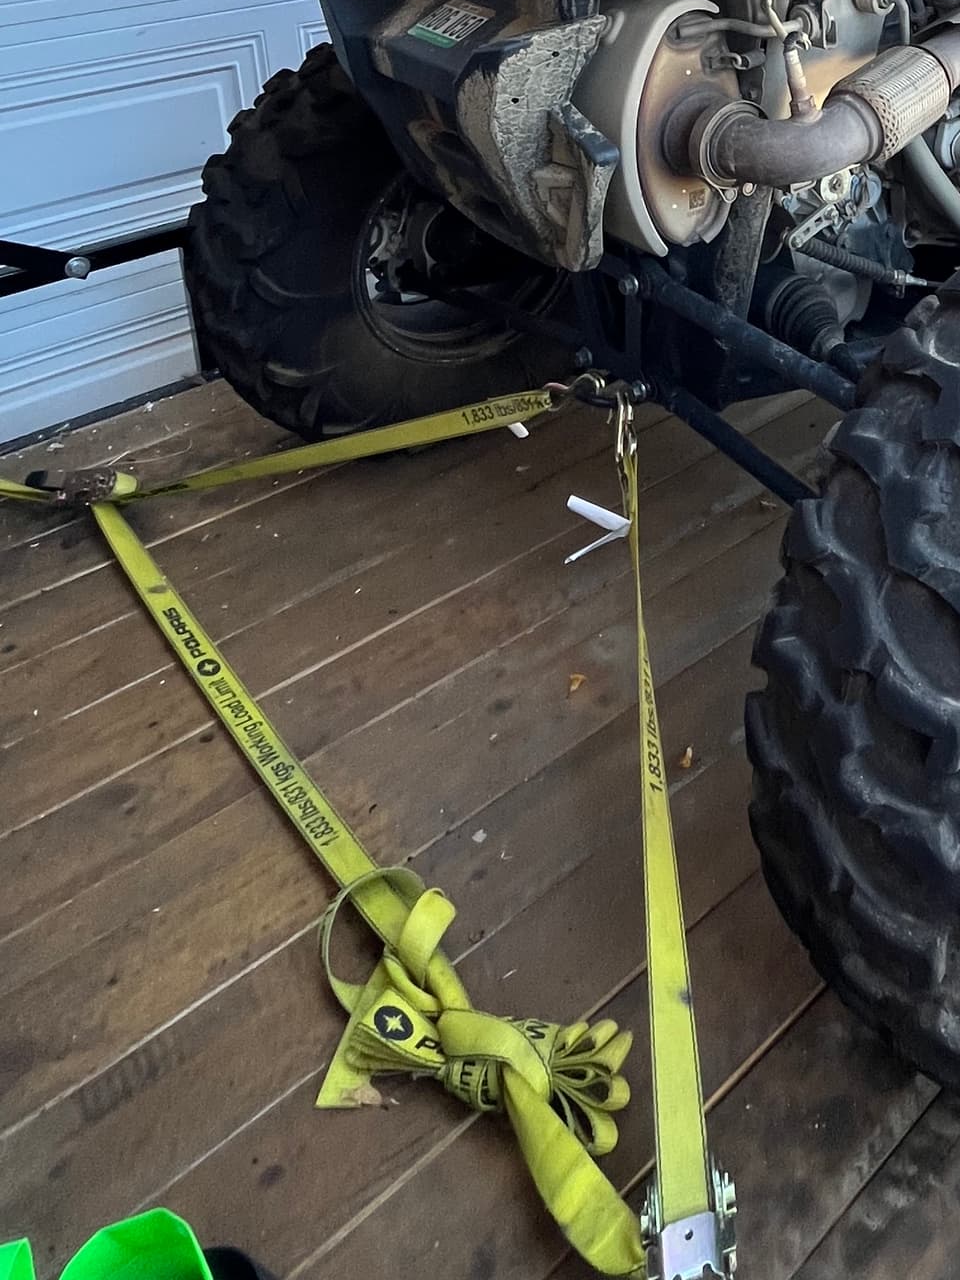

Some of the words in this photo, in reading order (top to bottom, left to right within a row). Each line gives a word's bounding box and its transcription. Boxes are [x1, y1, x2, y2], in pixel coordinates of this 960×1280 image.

[162, 607, 207, 659] POLARIS
[208, 676, 237, 705] Limit
[221, 700, 253, 728] Load
[243, 721, 280, 767] Working
[270, 761, 295, 786] kgs
[305, 816, 340, 847] 1,833
